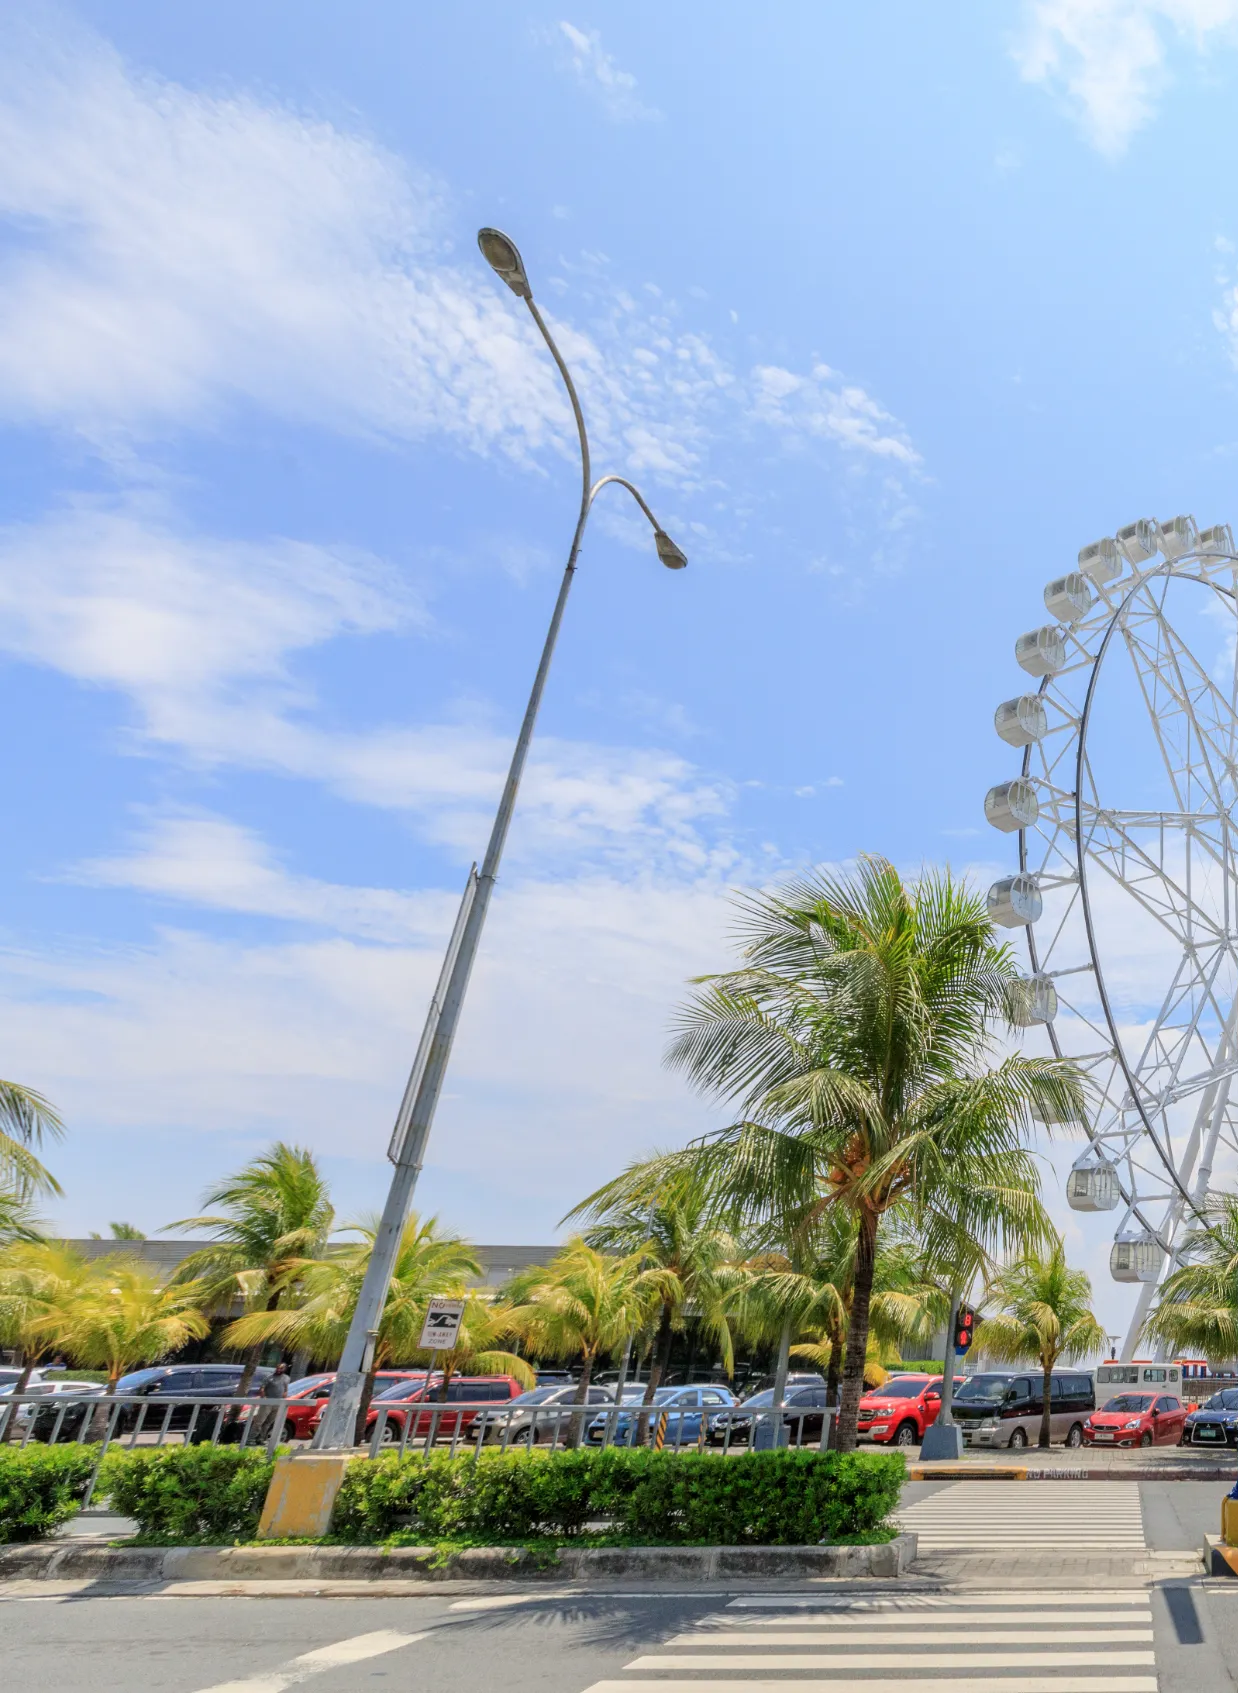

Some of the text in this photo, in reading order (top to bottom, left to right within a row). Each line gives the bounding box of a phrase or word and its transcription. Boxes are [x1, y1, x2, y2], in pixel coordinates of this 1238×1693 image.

[964, 1313, 973, 1327] 8
[1026, 1467, 1089, 1479] NO PARKING
